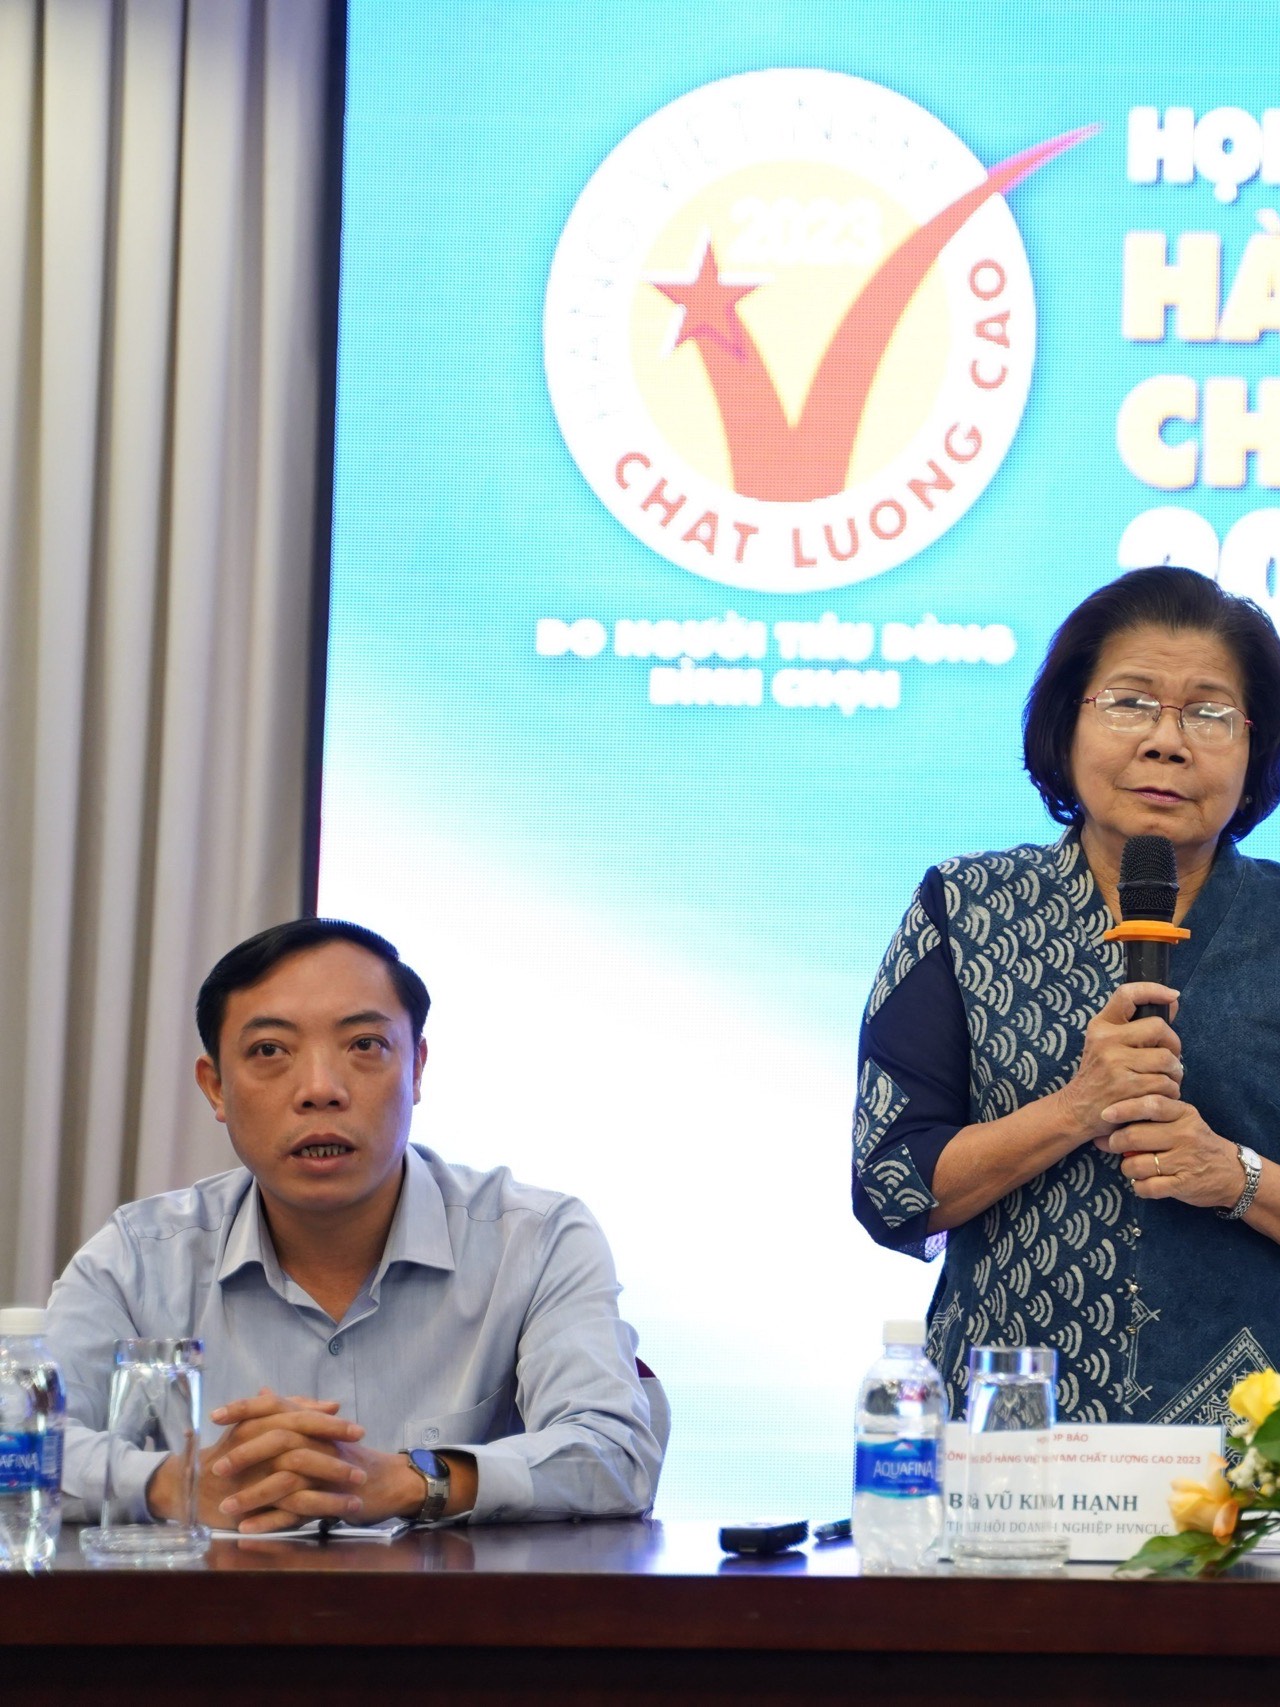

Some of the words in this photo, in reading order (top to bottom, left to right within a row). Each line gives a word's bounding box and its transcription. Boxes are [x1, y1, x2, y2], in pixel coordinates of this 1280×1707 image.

[970, 259, 1011, 390] CAO
[1066, 1432, 1089, 1443] BÁO
[1080, 1452, 1107, 1464] CHẤT
[1151, 1456, 1174, 1466] CAO
[1176, 1456, 1201, 1466] 2023
[873, 1459, 934, 1480] AQUAFINA
[986, 1490, 1013, 1511] VŨ
[1072, 1493, 1138, 1515] HẠNH
[1116, 1523, 1169, 1535] HVNCLC
